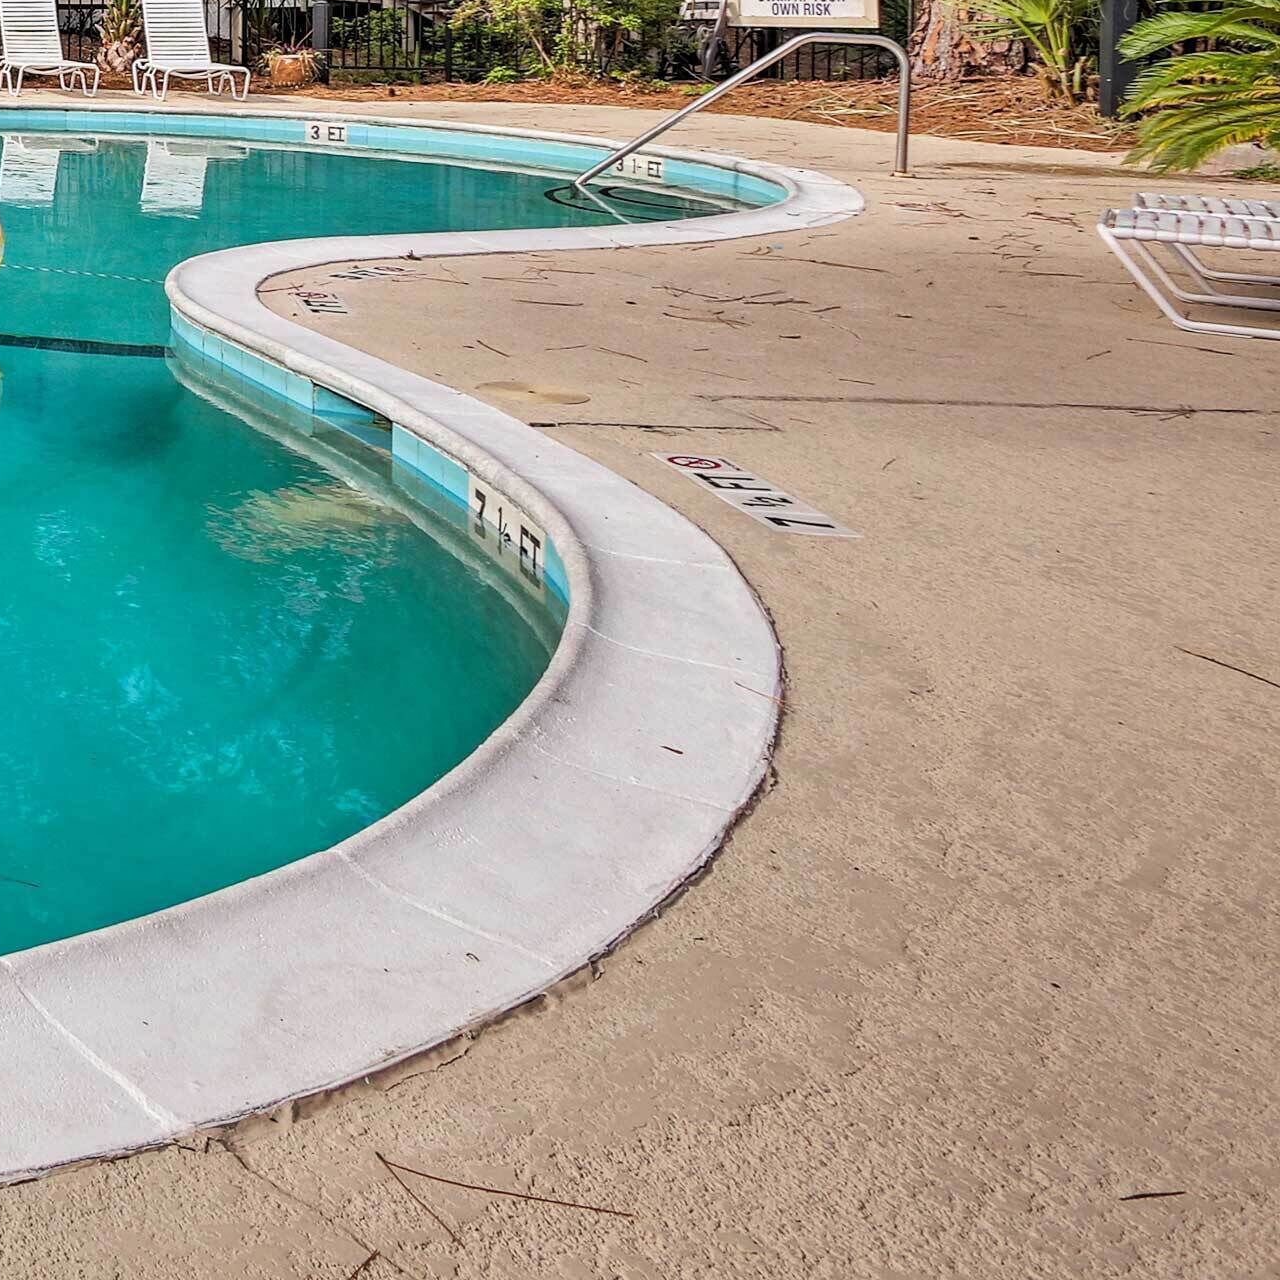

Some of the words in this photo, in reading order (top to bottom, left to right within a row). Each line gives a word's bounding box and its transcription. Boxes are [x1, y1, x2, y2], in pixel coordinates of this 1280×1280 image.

[772, 3, 800, 16] OWN
[803, 3, 831, 16] RISK
[693, 472, 773, 491] FT
